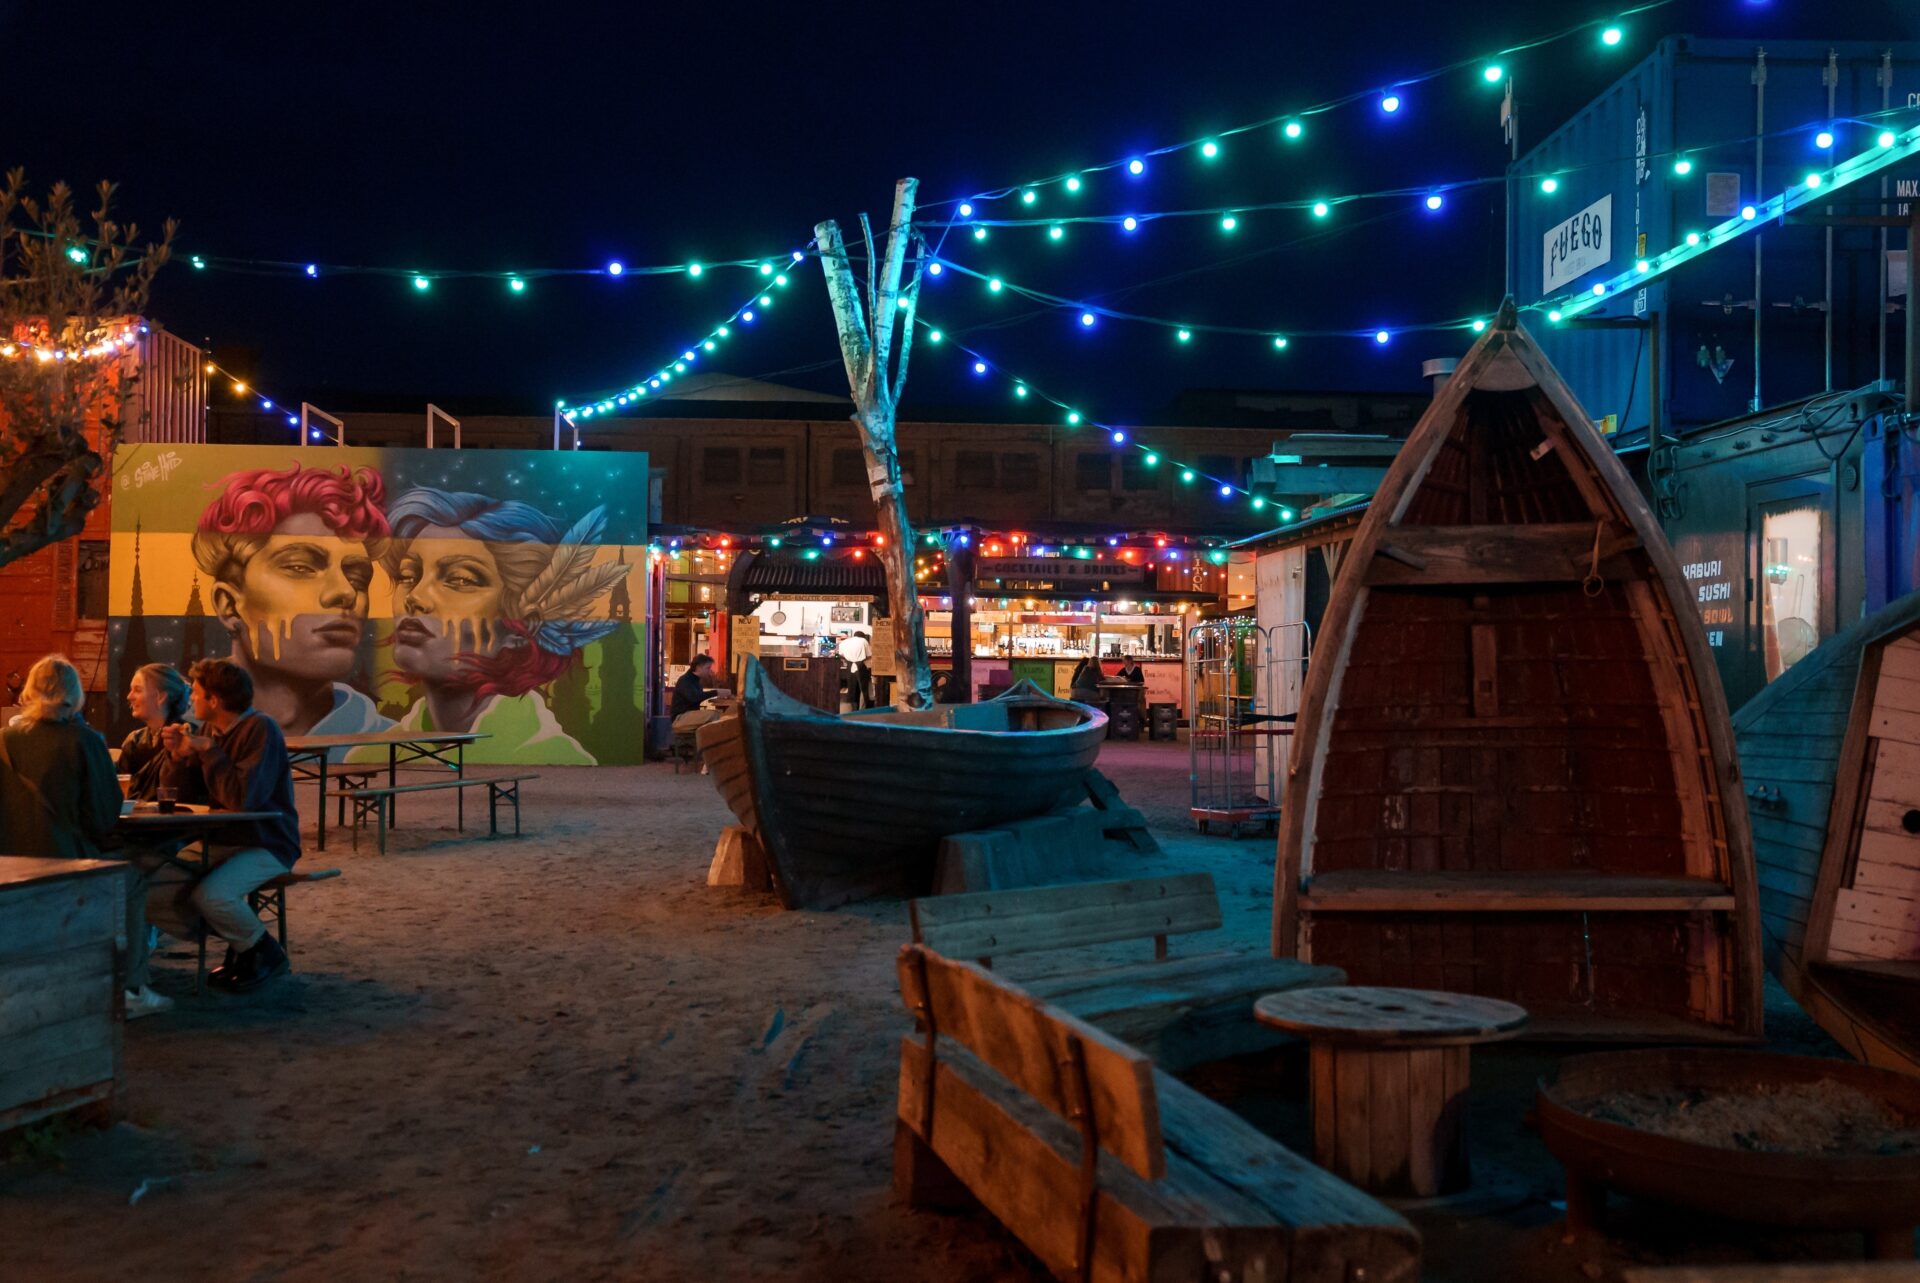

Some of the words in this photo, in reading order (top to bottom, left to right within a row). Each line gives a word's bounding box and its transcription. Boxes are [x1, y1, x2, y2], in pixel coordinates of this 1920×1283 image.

[1550, 212, 1602, 279] FUEGO
[995, 563, 1060, 574] COCKTAILS
[1084, 564, 1126, 575] DRINKS
[1698, 582, 1731, 602] SUSHI
[1704, 607, 1734, 624] BOWL
[1706, 631, 1723, 647] EN
